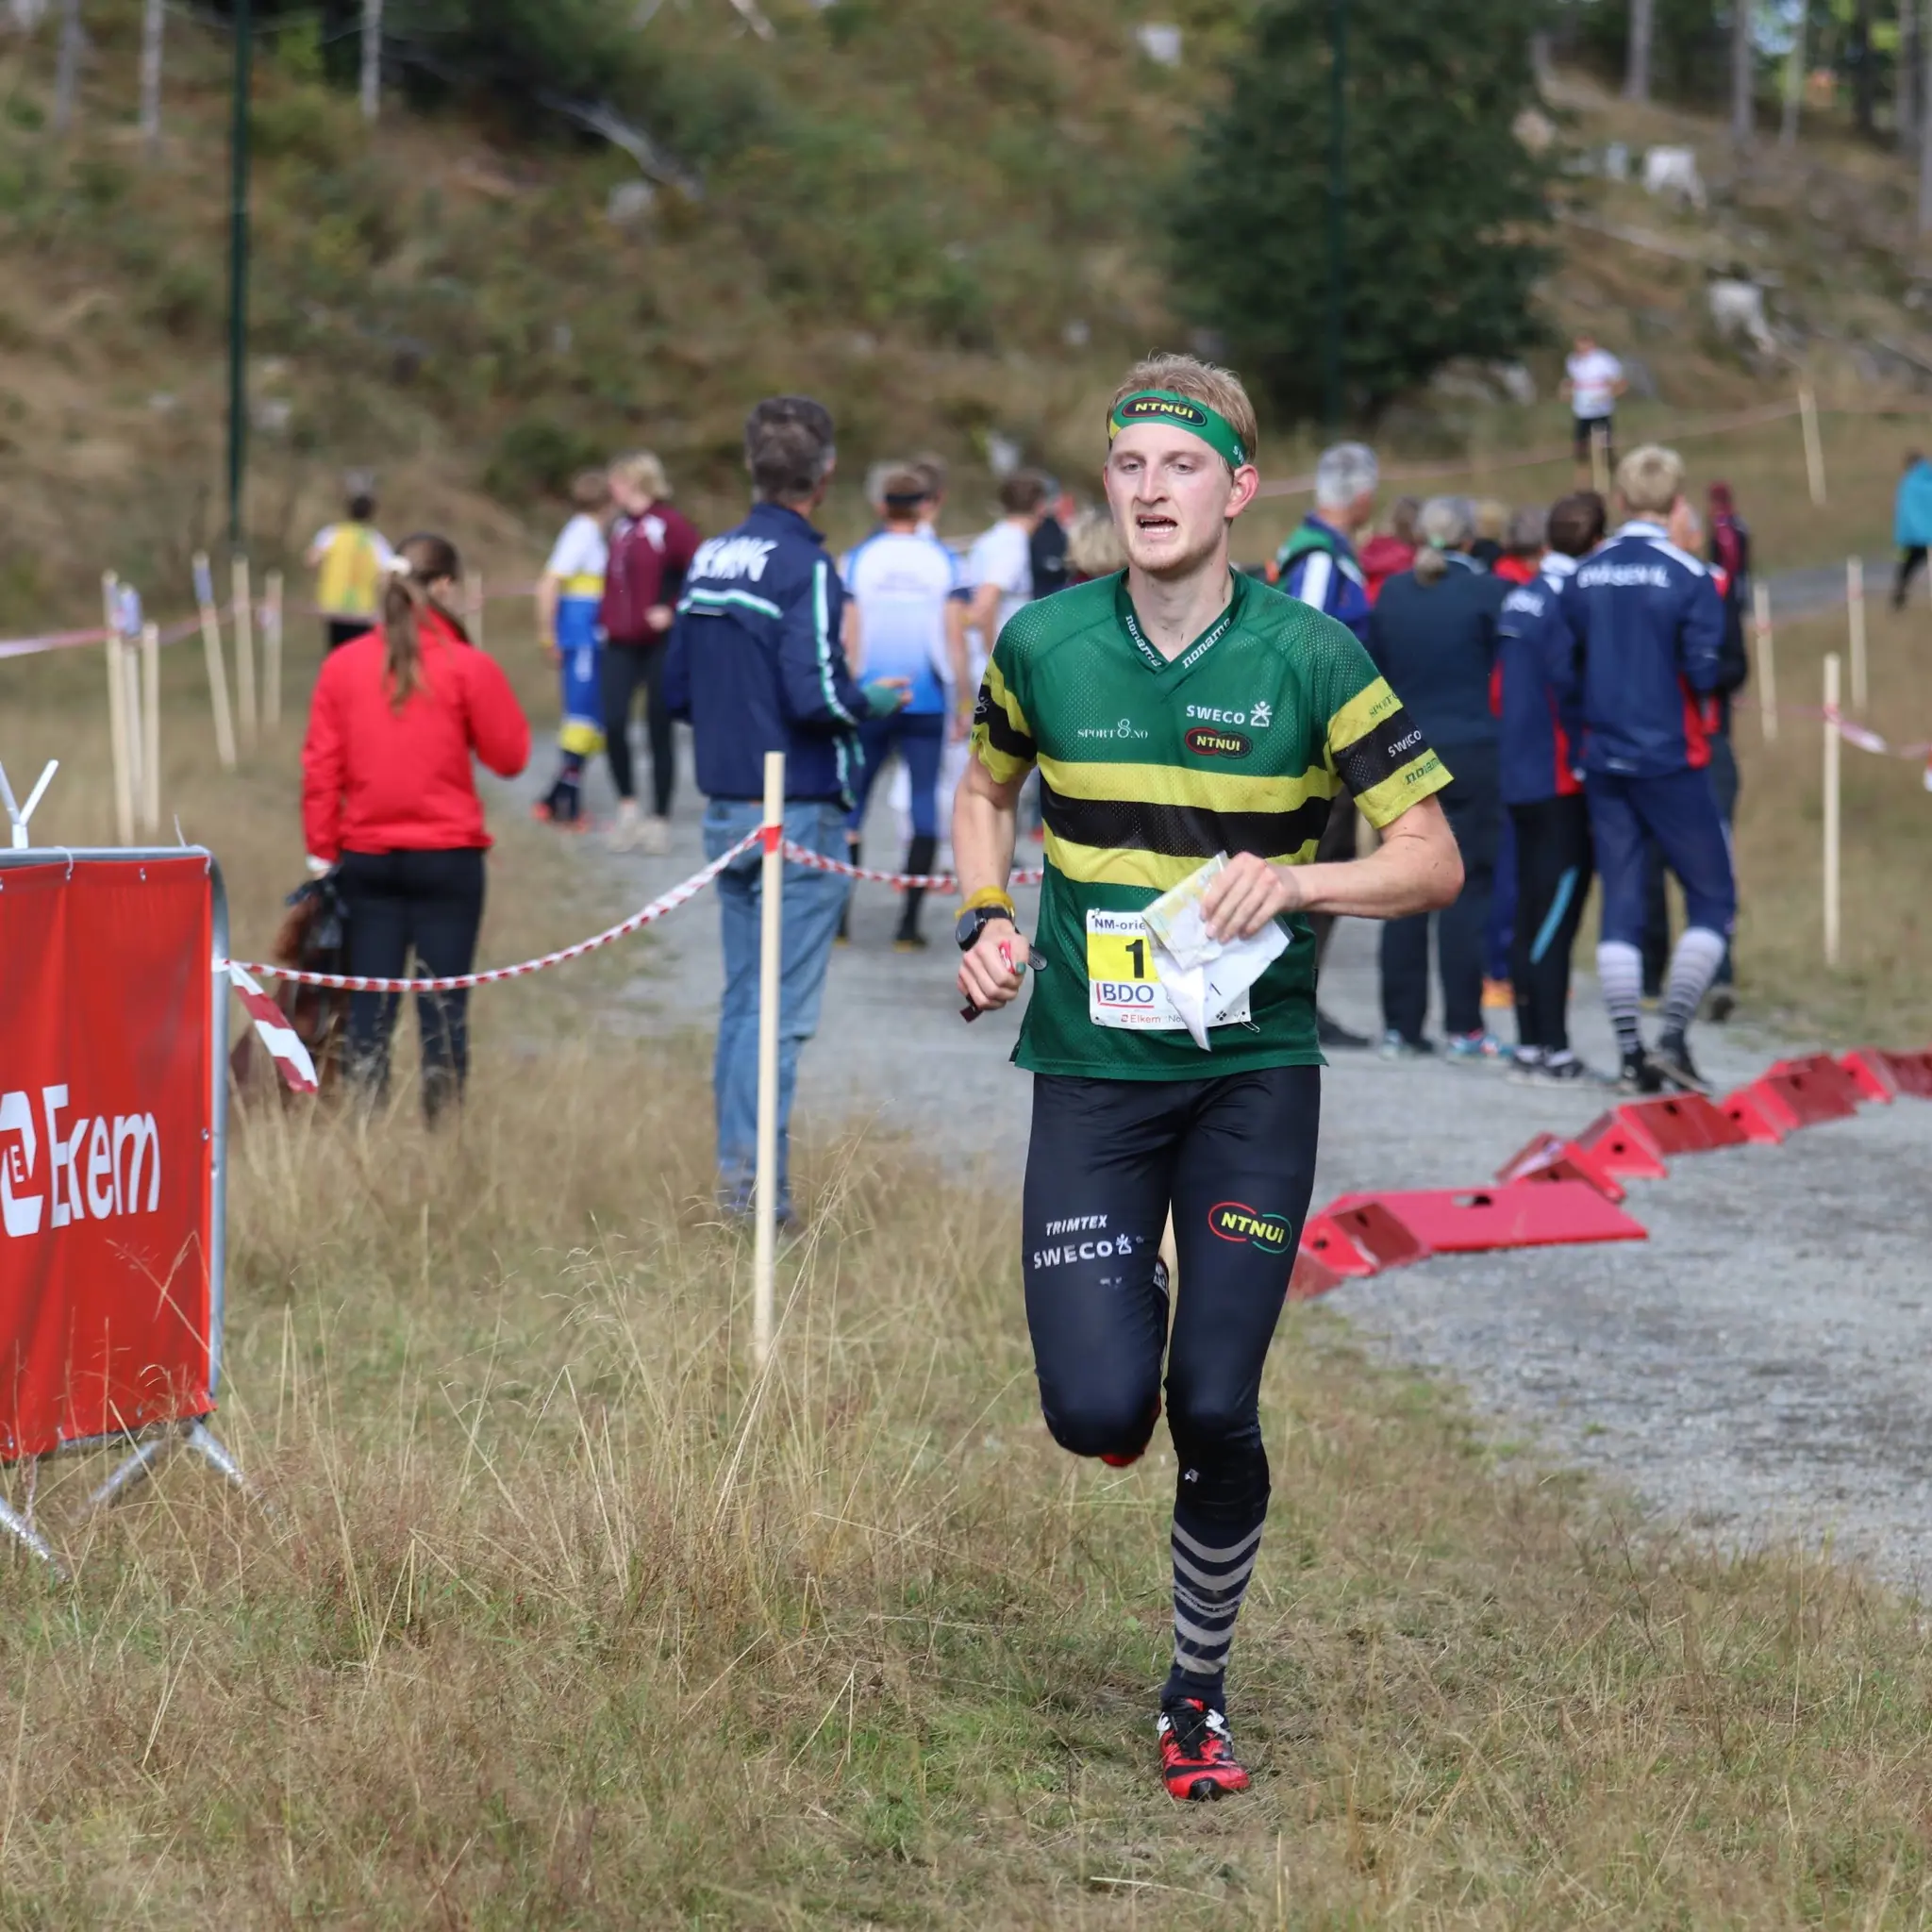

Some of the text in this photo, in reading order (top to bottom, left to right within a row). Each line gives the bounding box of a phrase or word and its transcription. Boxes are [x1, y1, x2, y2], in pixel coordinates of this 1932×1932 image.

[1135, 402, 1193, 419] NTNUI
[1125, 614, 1162, 667] noname
[1181, 618, 1231, 669] noname
[1186, 705, 1245, 724] SWECO
[1196, 735, 1241, 752] NTNUI
[1103, 983, 1155, 1004] BDO
[1130, 1014, 1161, 1024] Elkem
[1046, 1214, 1108, 1237] TRIMTEX
[1221, 1211, 1285, 1244] NTNUI
[1033, 1241, 1113, 1269] SWECO
